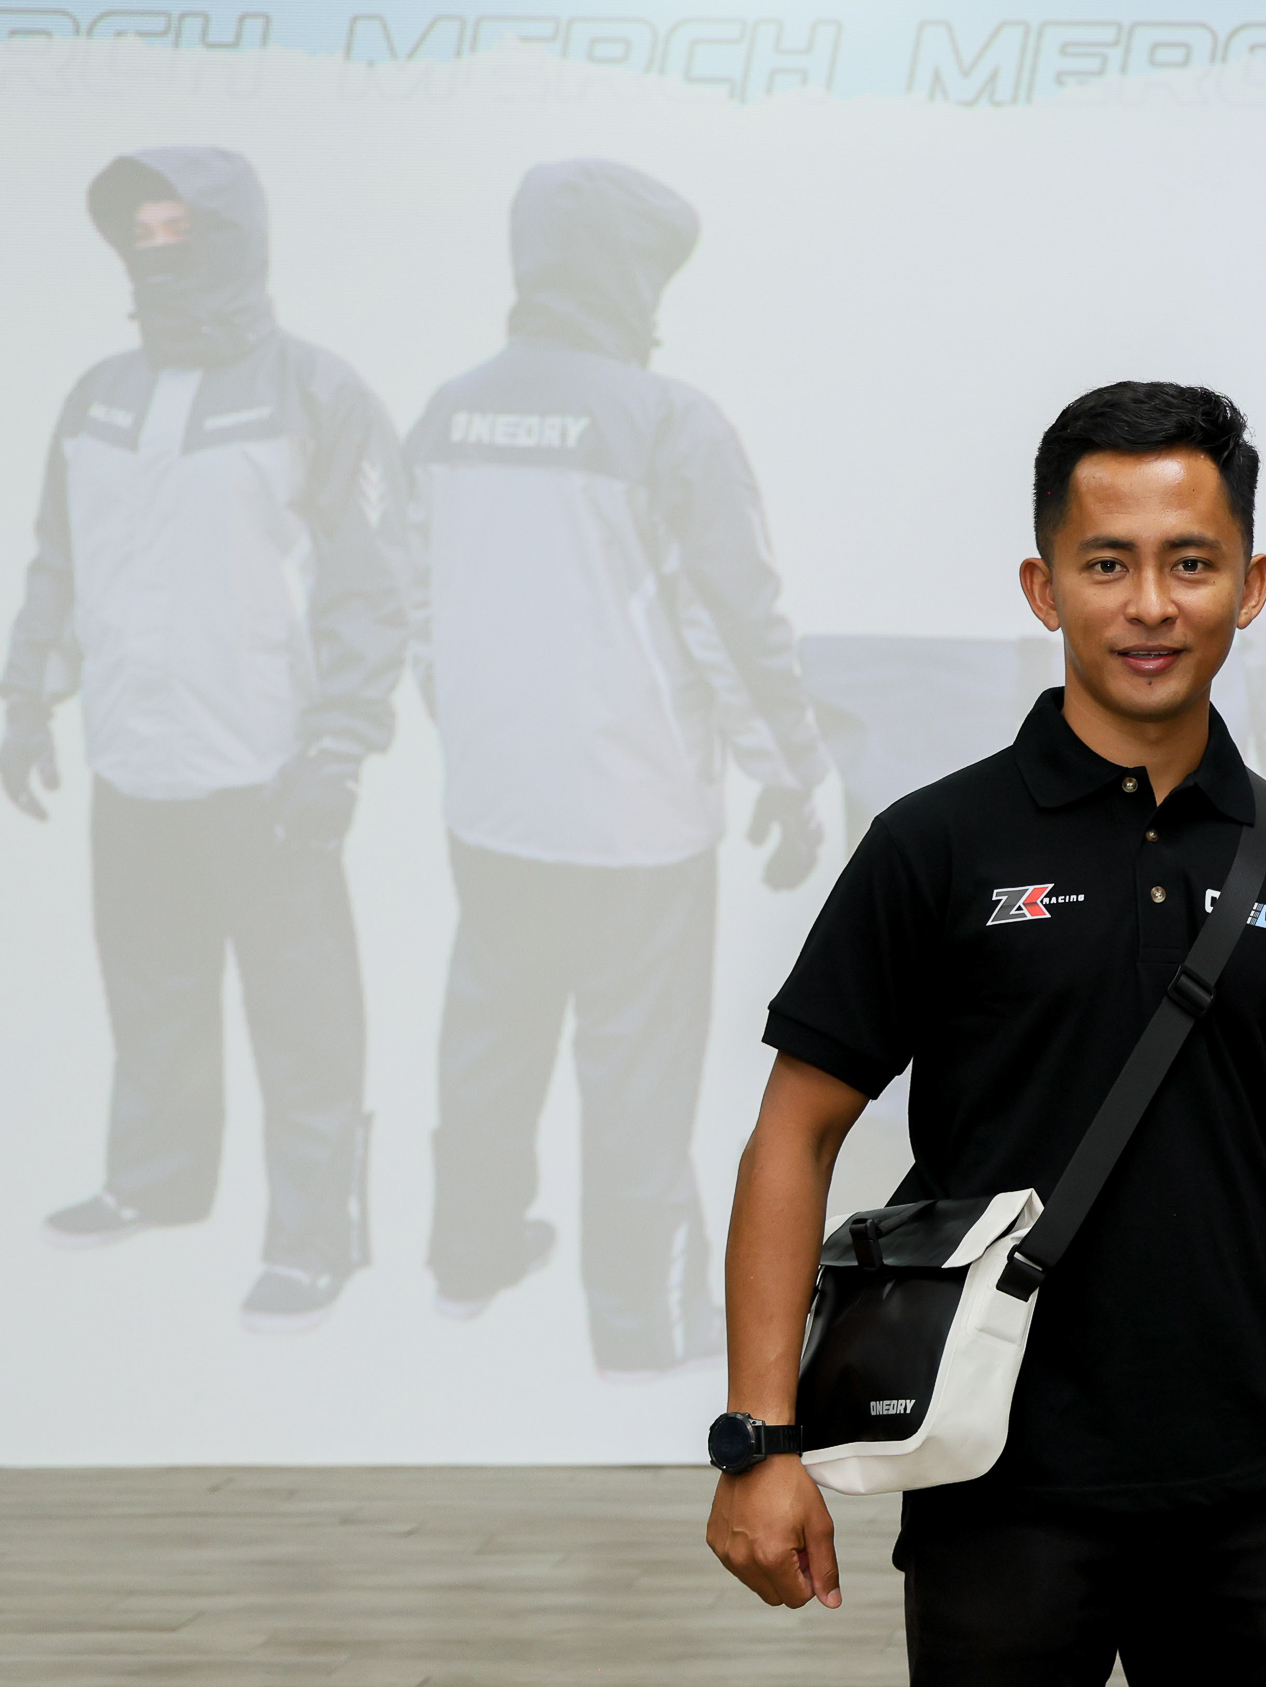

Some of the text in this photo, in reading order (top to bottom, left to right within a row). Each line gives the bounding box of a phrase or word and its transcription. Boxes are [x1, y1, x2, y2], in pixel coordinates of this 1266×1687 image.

[337, 14, 844, 104] MERCH
[1042, 894, 1085, 905] RACING
[870, 1399, 916, 1416] ONEDRY
